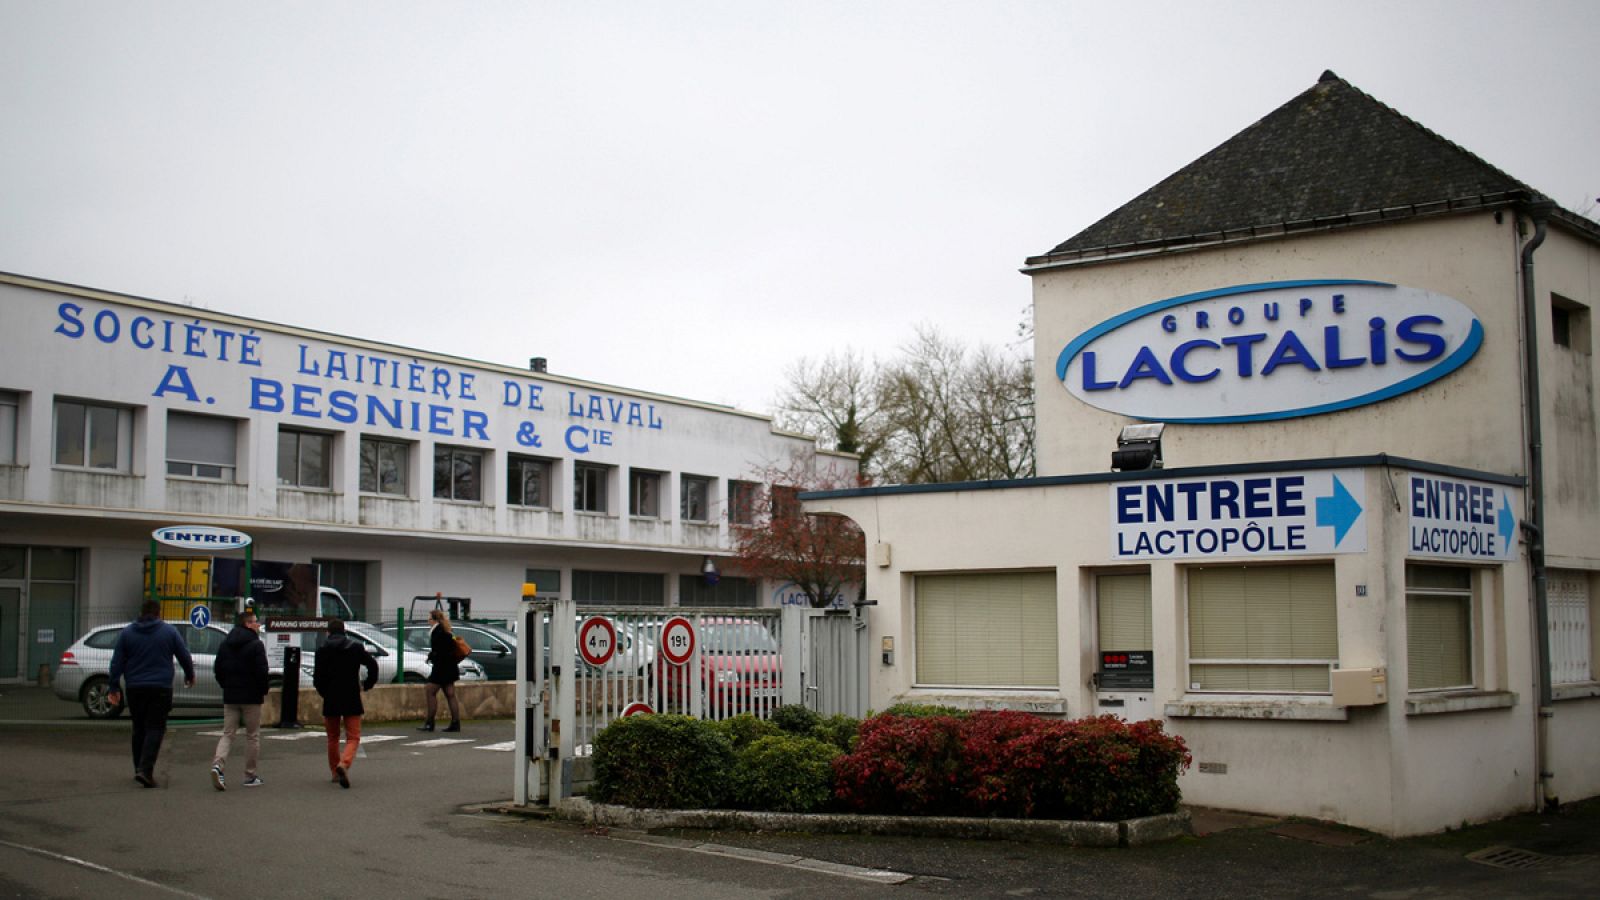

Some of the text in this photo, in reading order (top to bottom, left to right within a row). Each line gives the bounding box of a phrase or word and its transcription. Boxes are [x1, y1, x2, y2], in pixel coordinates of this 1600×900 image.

[1161, 294, 1346, 333] GROUPE
[55, 302, 663, 430] SOCIÉTÉ LAITIÈRE DE LAVAL
[152, 364, 216, 405] A.
[249, 376, 491, 441] BESNIER
[516, 421, 543, 448] &
[1116, 475, 1307, 524] ENTREE
[1411, 477, 1496, 526] ENTREE
[163, 531, 241, 544] ENTREE
[1117, 520, 1307, 556] LACTOPÔLE
[1412, 525, 1496, 557] LACTOPÔLE
[270, 620, 298, 628] PARKING
[589, 635, 608, 648] 4 m
